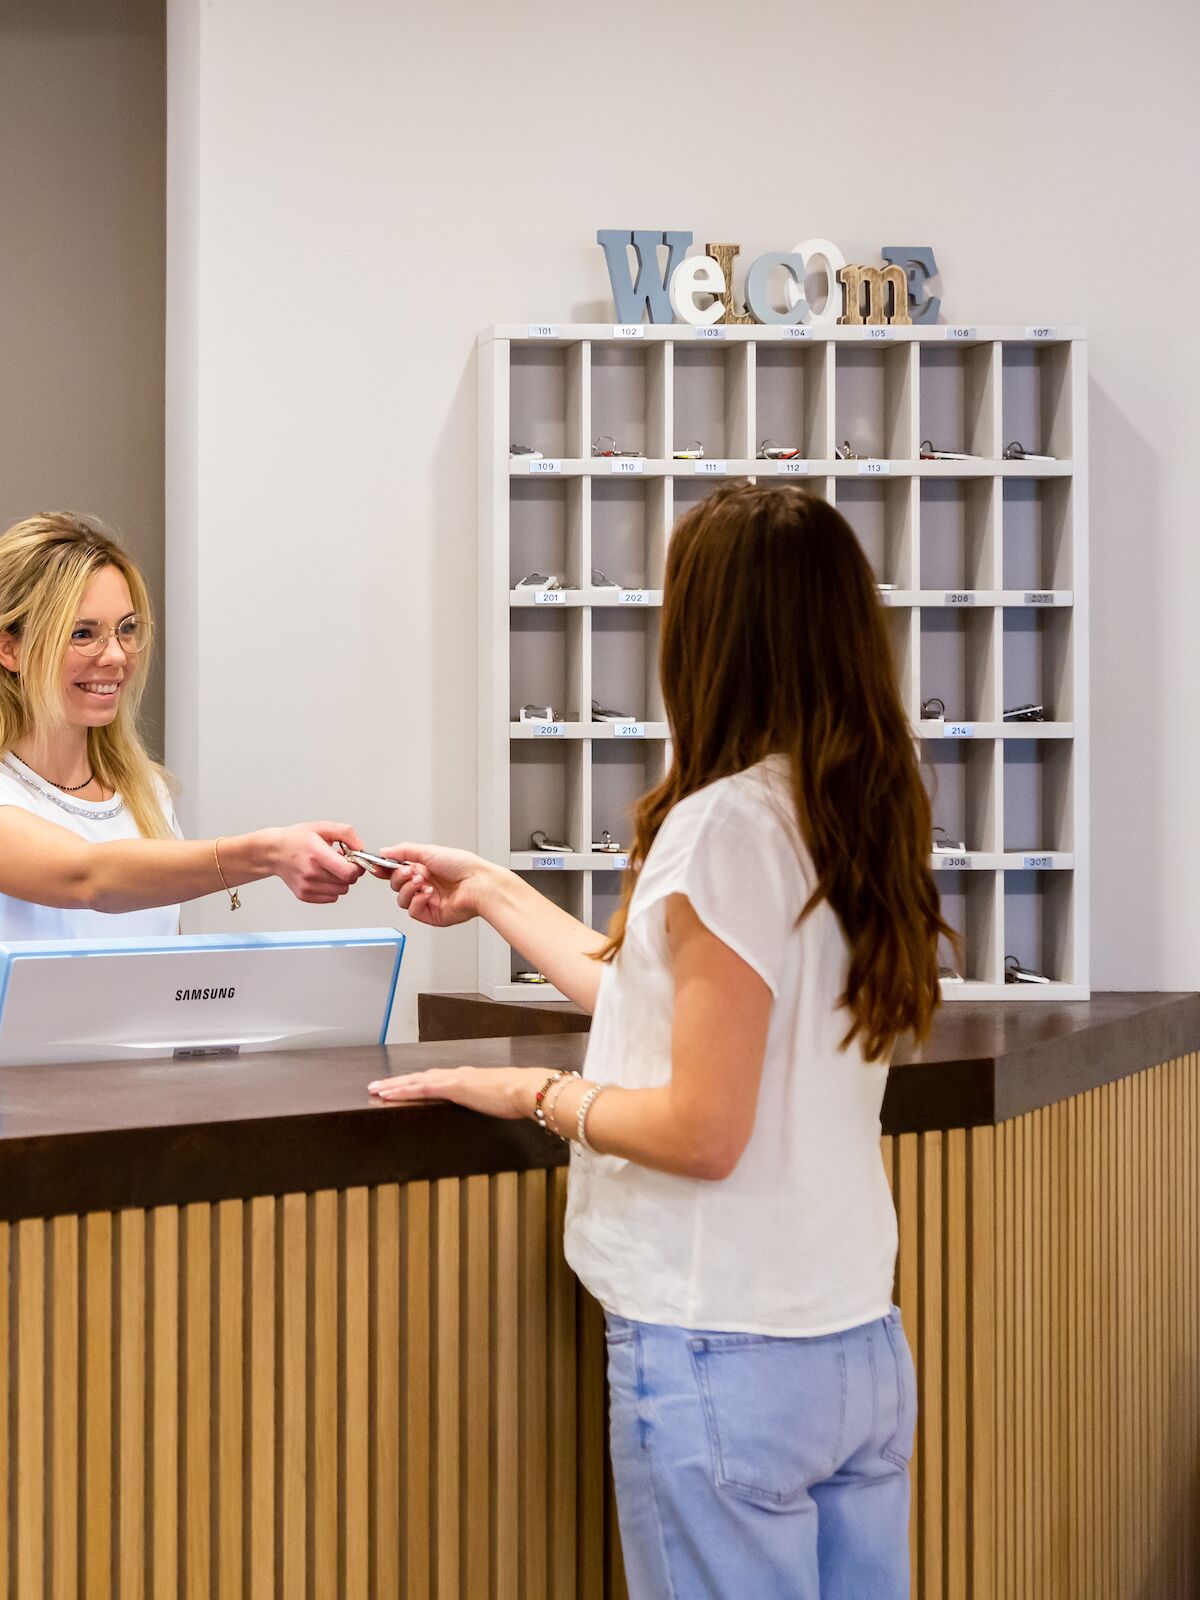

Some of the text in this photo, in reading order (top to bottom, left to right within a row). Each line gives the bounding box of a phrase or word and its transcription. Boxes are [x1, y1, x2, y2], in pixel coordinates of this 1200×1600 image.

[538, 327, 552, 335] 101
[621, 328, 637, 336] 102
[703, 328, 719, 338] 103
[790, 329, 805, 337] 104
[871, 329, 886, 338] 105
[953, 329, 969, 337] 106
[1033, 329, 1049, 337] 107
[538, 463, 554, 471] 109
[621, 463, 635, 471] 110
[705, 463, 717, 471] 111
[786, 464, 800, 472] 112
[867, 464, 881, 472] 113
[543, 593, 558, 602] 201
[625, 594, 642, 602] 202
[540, 726, 558, 734] 209
[622, 726, 638, 735] 210
[951, 727, 967, 735] 214
[540, 857, 556, 866] 301
[1029, 857, 1048, 867] 307
[175, 987, 236, 1001] SAMSUNG
